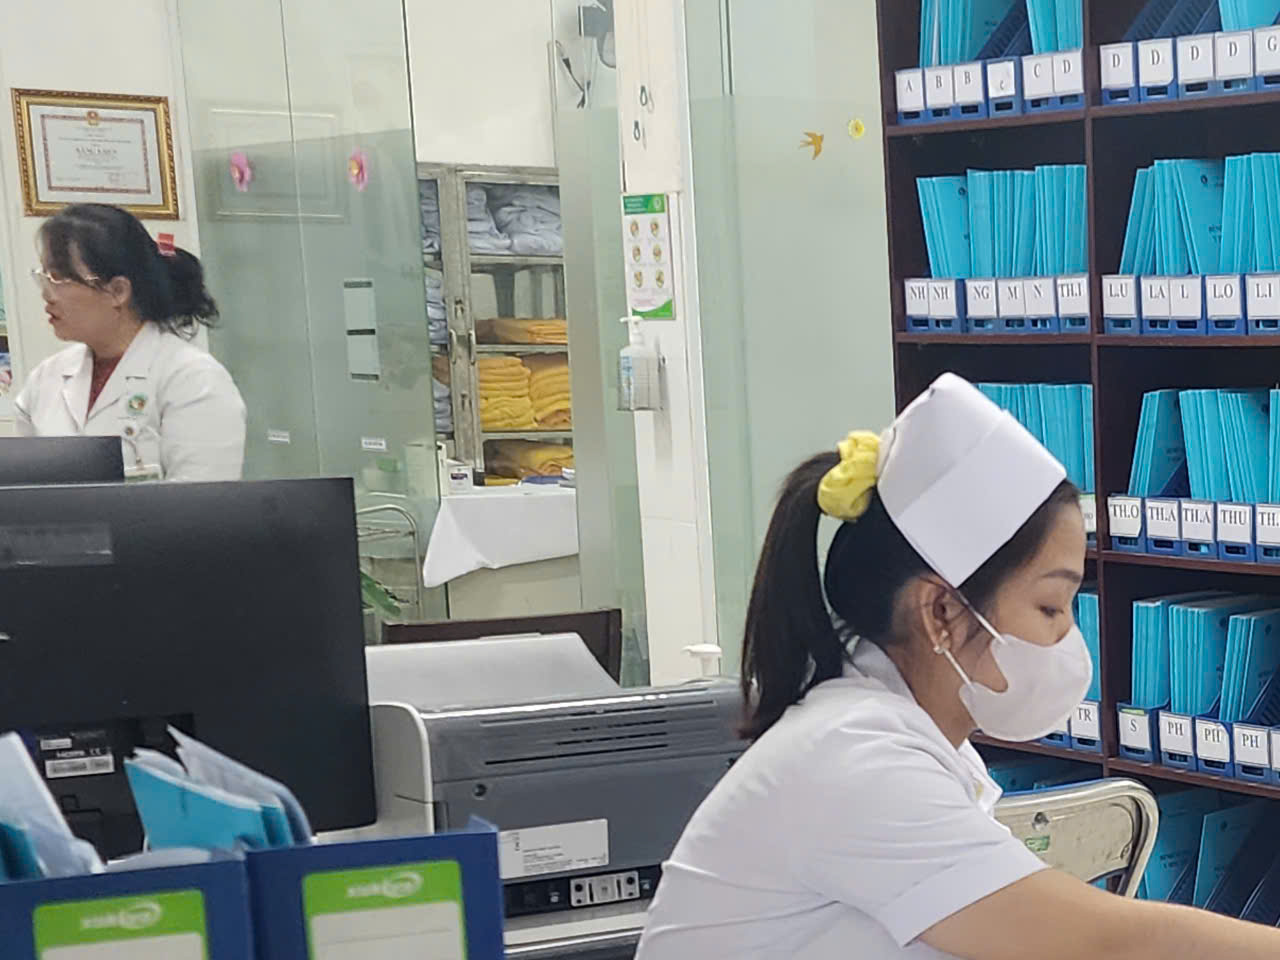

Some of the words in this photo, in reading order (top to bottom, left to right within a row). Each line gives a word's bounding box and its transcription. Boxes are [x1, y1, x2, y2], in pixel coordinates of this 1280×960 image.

[1228, 41, 1238, 57] D
[1267, 35, 1278, 52] G
[1151, 49, 1161, 66] D
[1190, 44, 1200, 61] D
[1062, 59, 1071, 74] D
[1112, 53, 1121, 68] D
[964, 71, 971, 85] B
[1033, 63, 1041, 79] C
[905, 79, 913, 92] A
[935, 75, 942, 89] B
[910, 284, 926, 300] NH
[933, 284, 949, 301] NH
[973, 284, 990, 301] NG
[1007, 285, 1018, 300] M
[1033, 283, 1042, 299] N
[1181, 284, 1189, 299] L
[1109, 503, 1140, 519] TH.O
[1148, 506, 1177, 521] TH.A
[1183, 507, 1212, 524] TH.A
[1077, 707, 1092, 722] TR
[1129, 718, 1138, 732] S
[1167, 721, 1184, 736] PH
[1204, 728, 1221, 743] PH
[1241, 733, 1259, 749] PH
